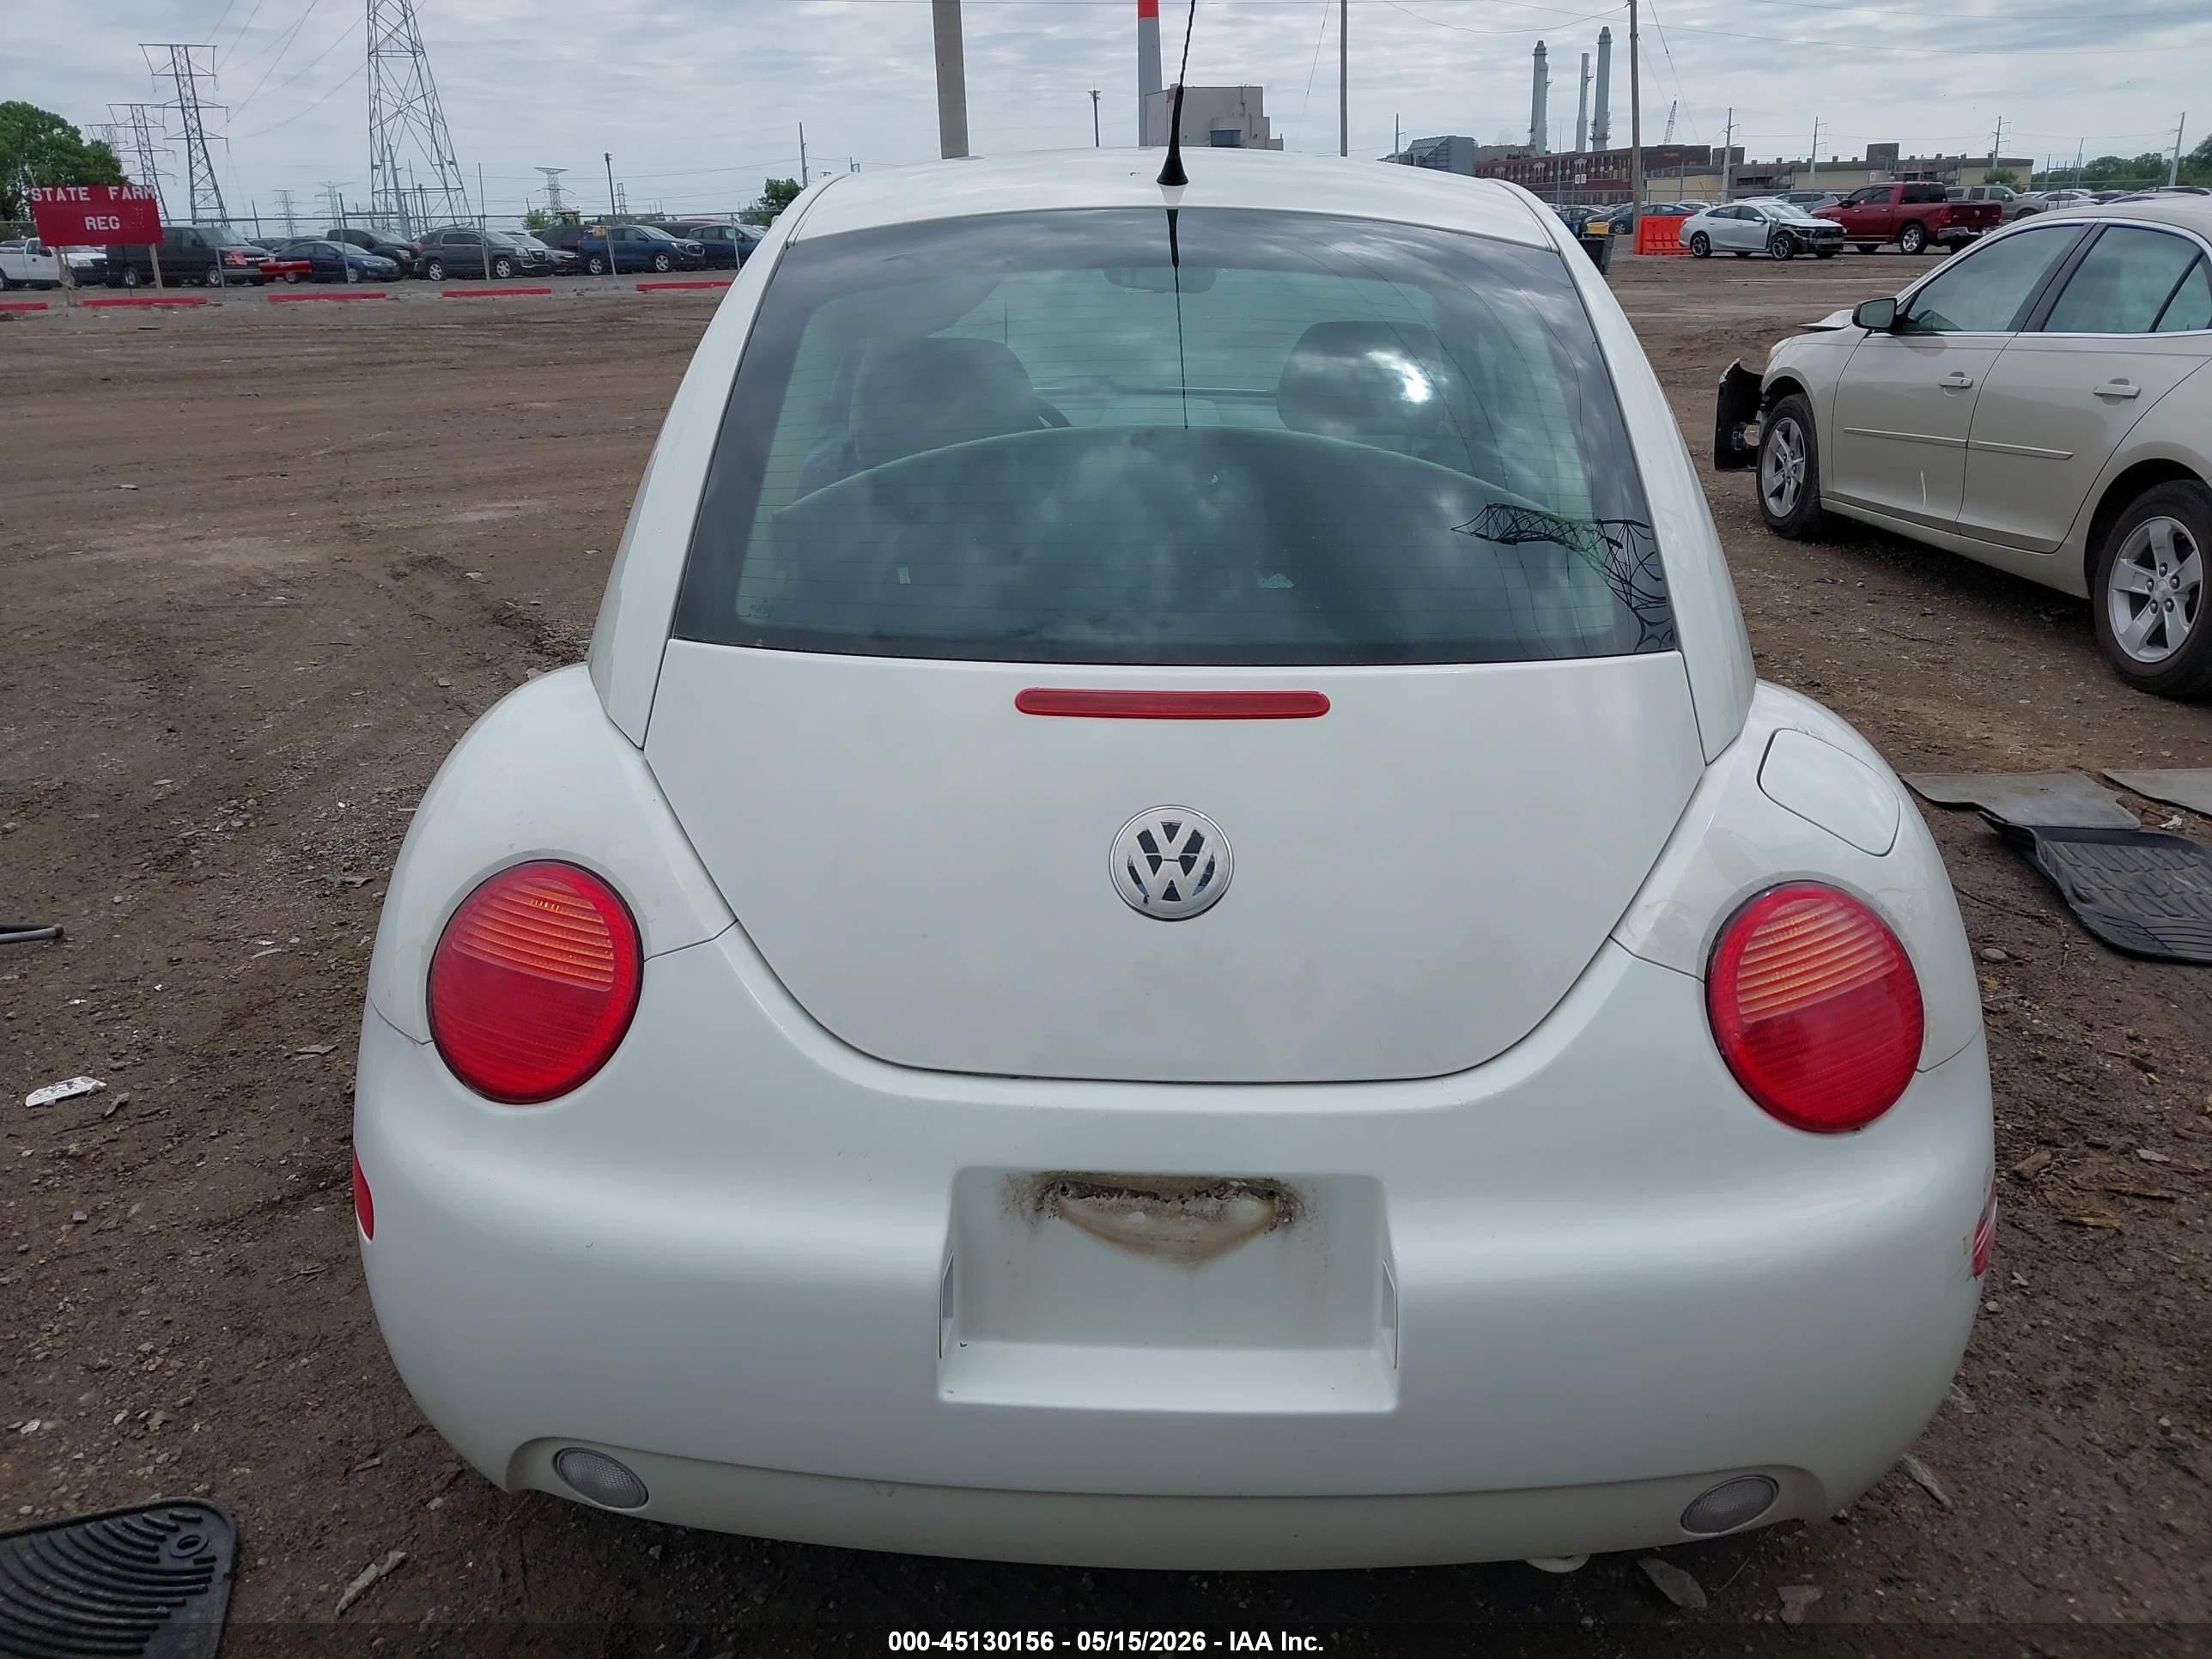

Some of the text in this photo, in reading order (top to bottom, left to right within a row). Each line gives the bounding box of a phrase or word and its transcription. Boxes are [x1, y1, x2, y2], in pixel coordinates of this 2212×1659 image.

[30, 185, 155, 202] STATE FARM
[85, 216, 120, 231] REG
